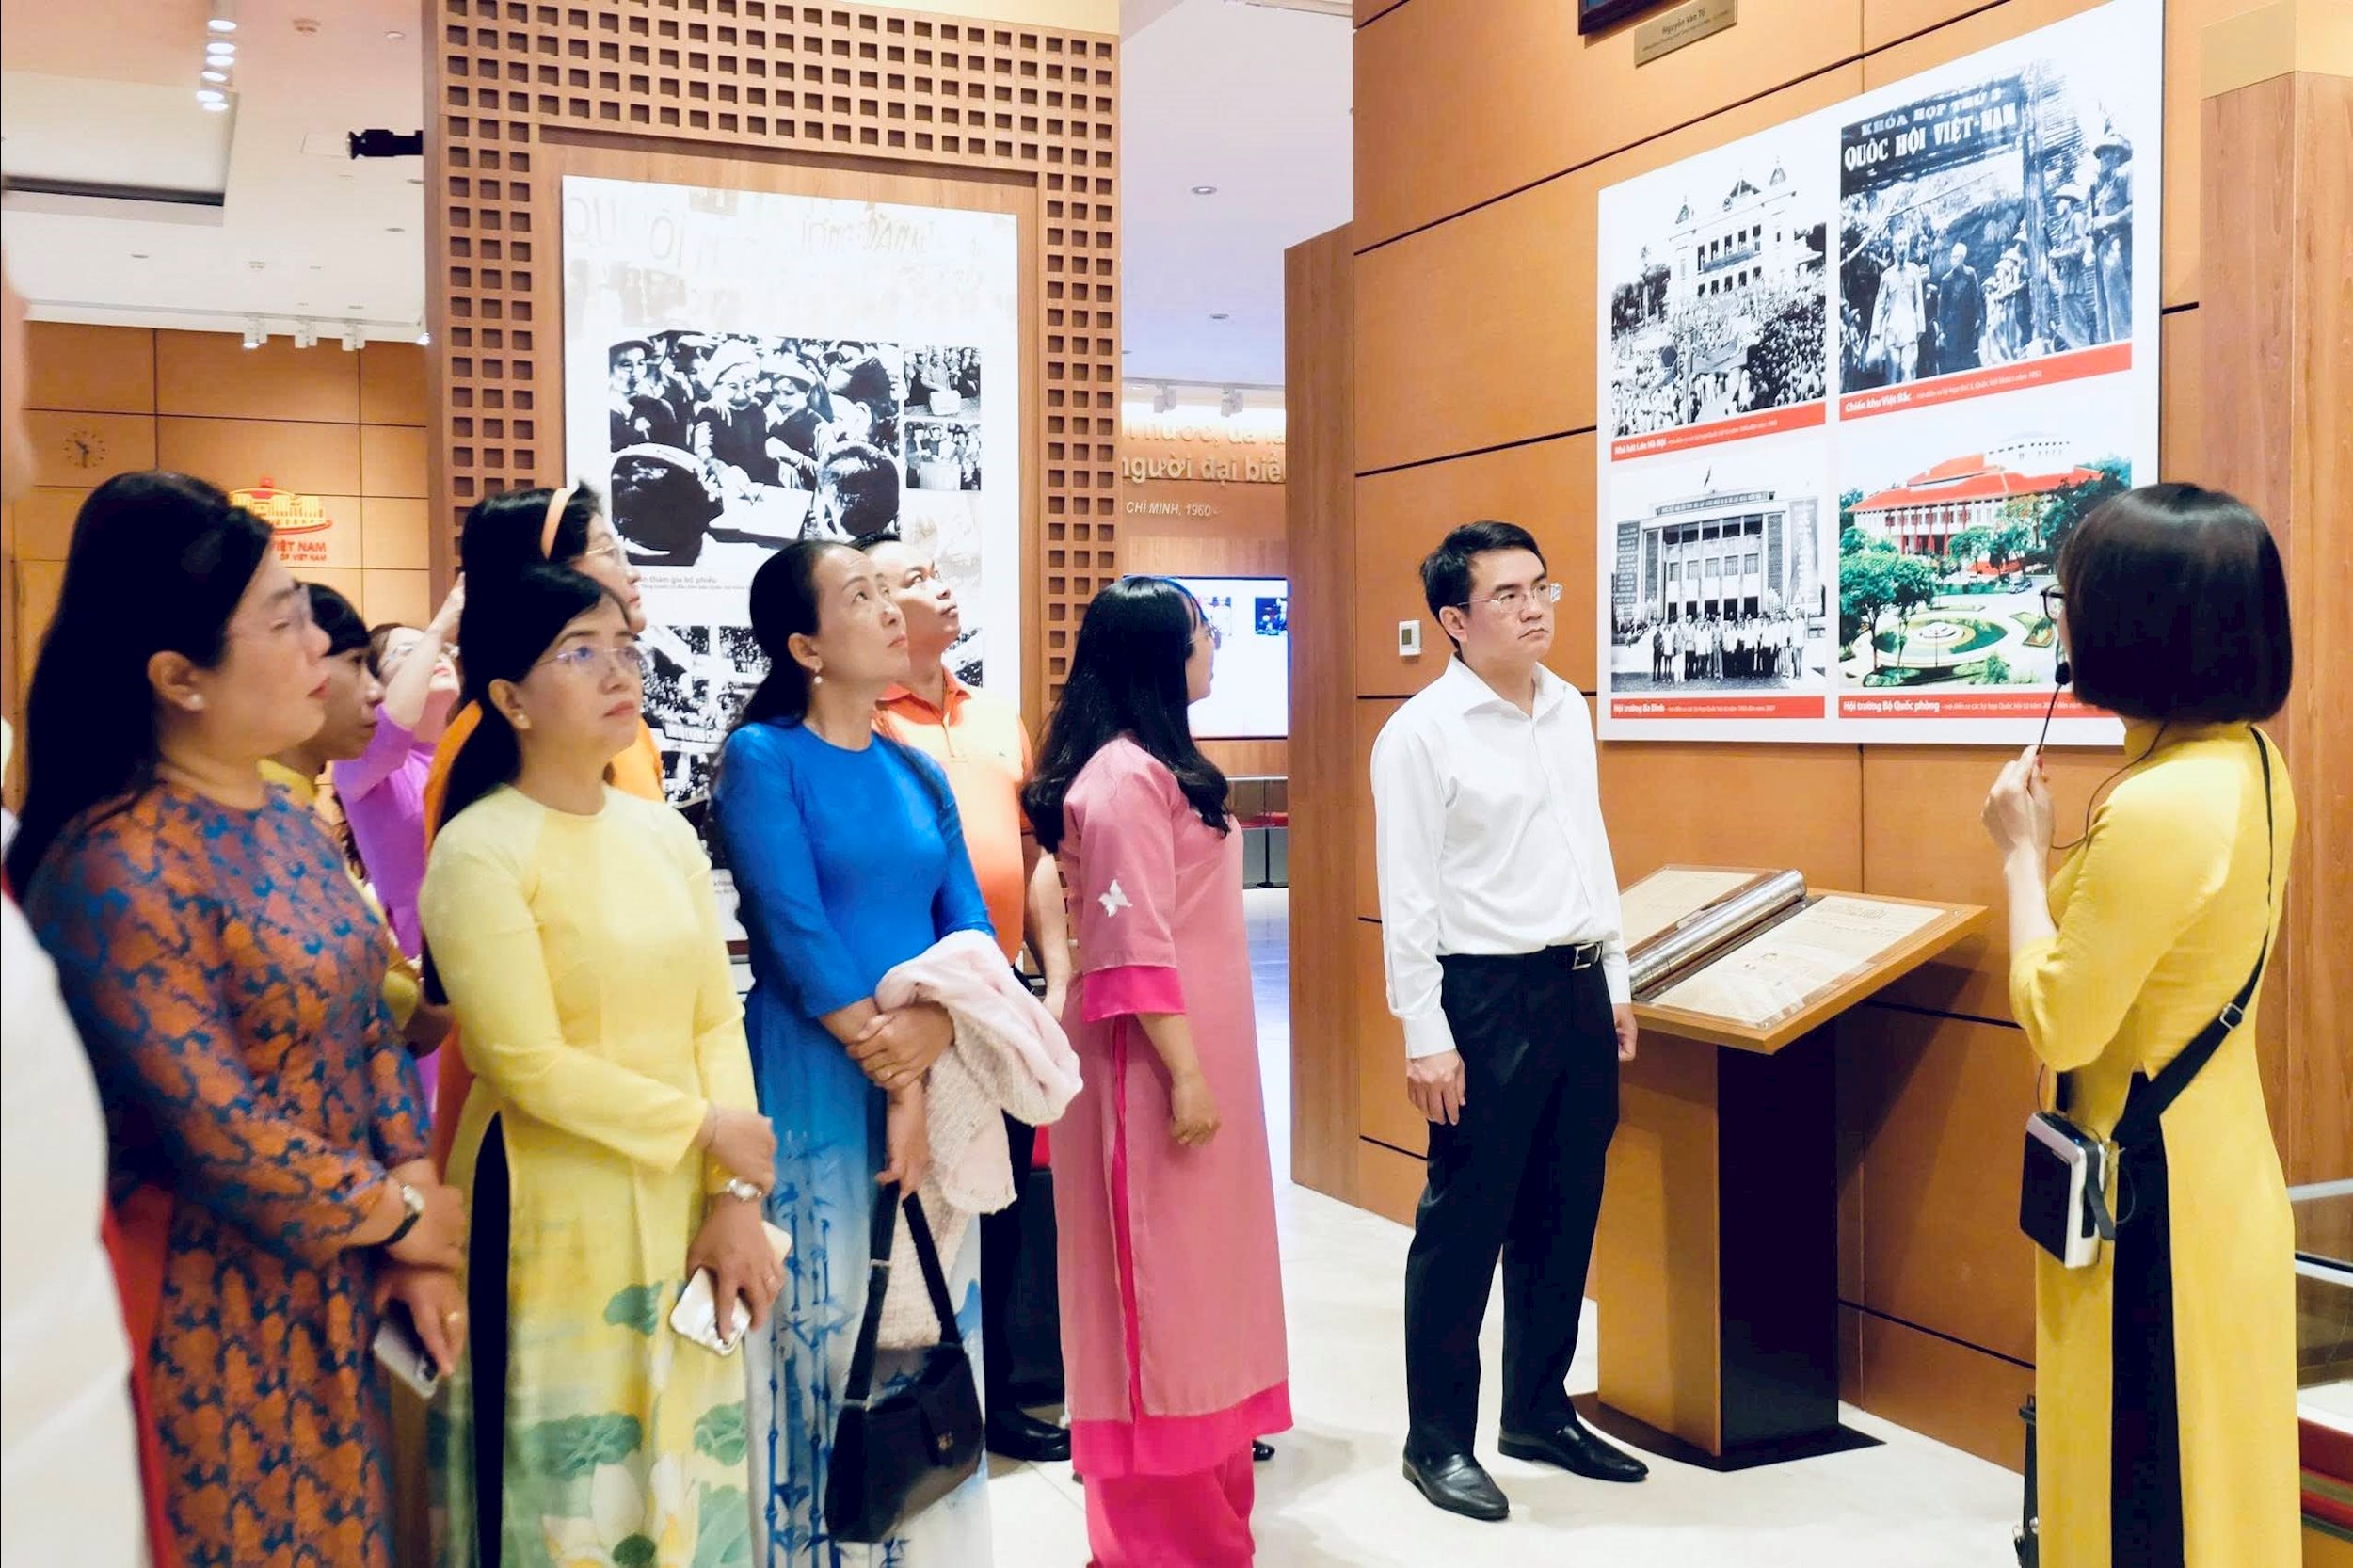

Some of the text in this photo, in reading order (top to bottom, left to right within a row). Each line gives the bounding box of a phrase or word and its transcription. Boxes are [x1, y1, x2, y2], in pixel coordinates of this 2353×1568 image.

[1895, 127, 1927, 158] HỘI
[1201, 455, 1238, 487] đại
[1843, 700, 1857, 712] Hội
[1894, 699, 1914, 712] Quốc
